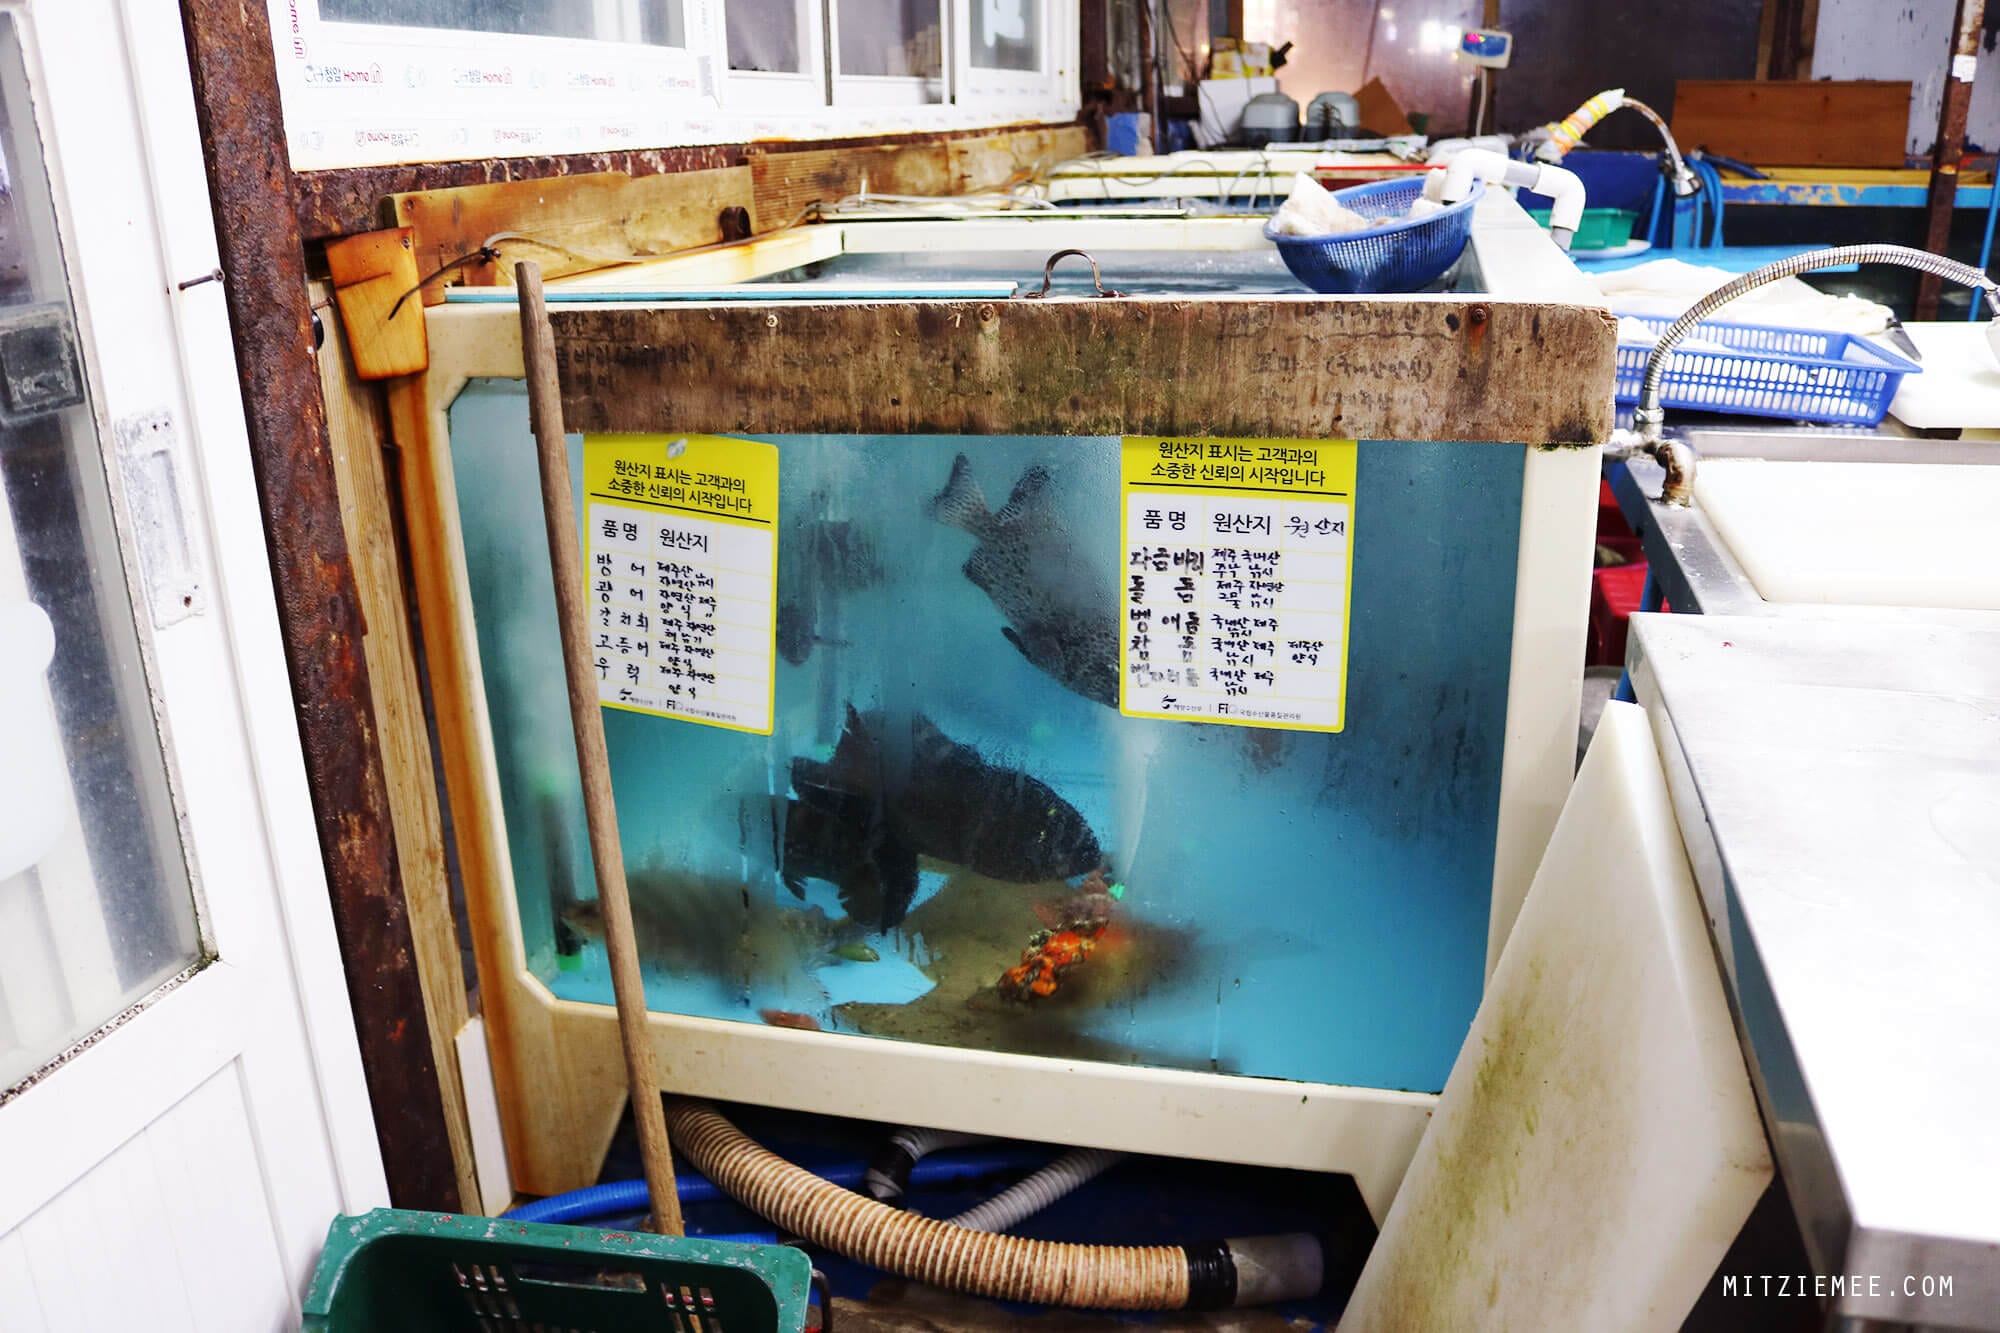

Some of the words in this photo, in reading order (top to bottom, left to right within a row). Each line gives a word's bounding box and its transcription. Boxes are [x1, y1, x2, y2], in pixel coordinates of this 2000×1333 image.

[289, 0, 299, 34] ome
[1159, 441, 1203, 460] 원산지
[1208, 445, 1253, 462] 표시는
[1256, 447, 1318, 466] 고객과의
[614, 459, 651, 479] 원산지
[654, 466, 692, 485] 표시는
[695, 472, 746, 493] 고객과의
[1151, 462, 1196, 480] 소중한
[1200, 463, 1244, 482] 신뢰의
[1249, 467, 1326, 487] 시작입니다
[608, 477, 645, 496] 소중한
[648, 483, 685, 502] 신뢰의
[689, 490, 753, 512] 시작입니다
[1213, 513, 1271, 535] 원산지
[660, 528, 708, 552] 원산지
